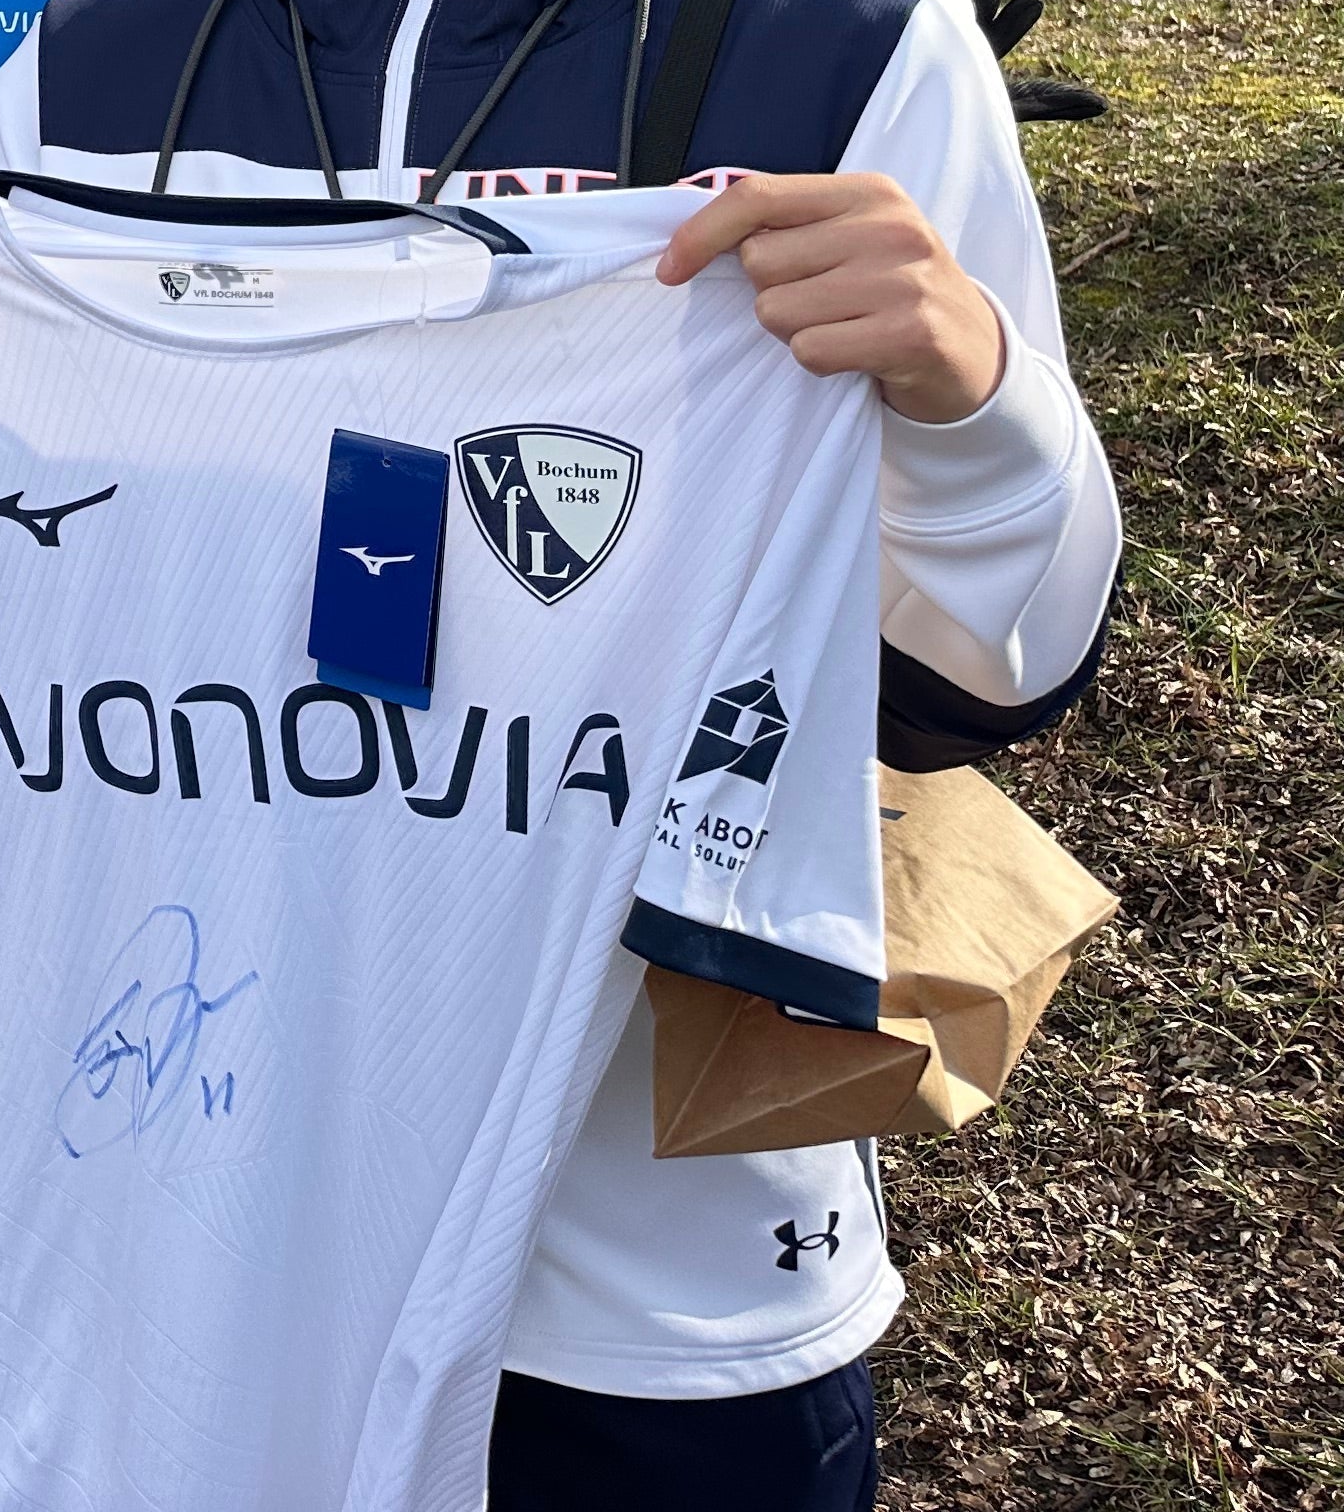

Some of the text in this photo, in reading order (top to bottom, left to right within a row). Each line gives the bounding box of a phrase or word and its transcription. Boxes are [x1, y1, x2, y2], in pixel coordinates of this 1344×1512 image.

[211, 290, 252, 299] BOCHUM
[254, 291, 275, 299] 1848
[536, 460, 619, 480] Bochum
[555, 486, 601, 505] 1848
